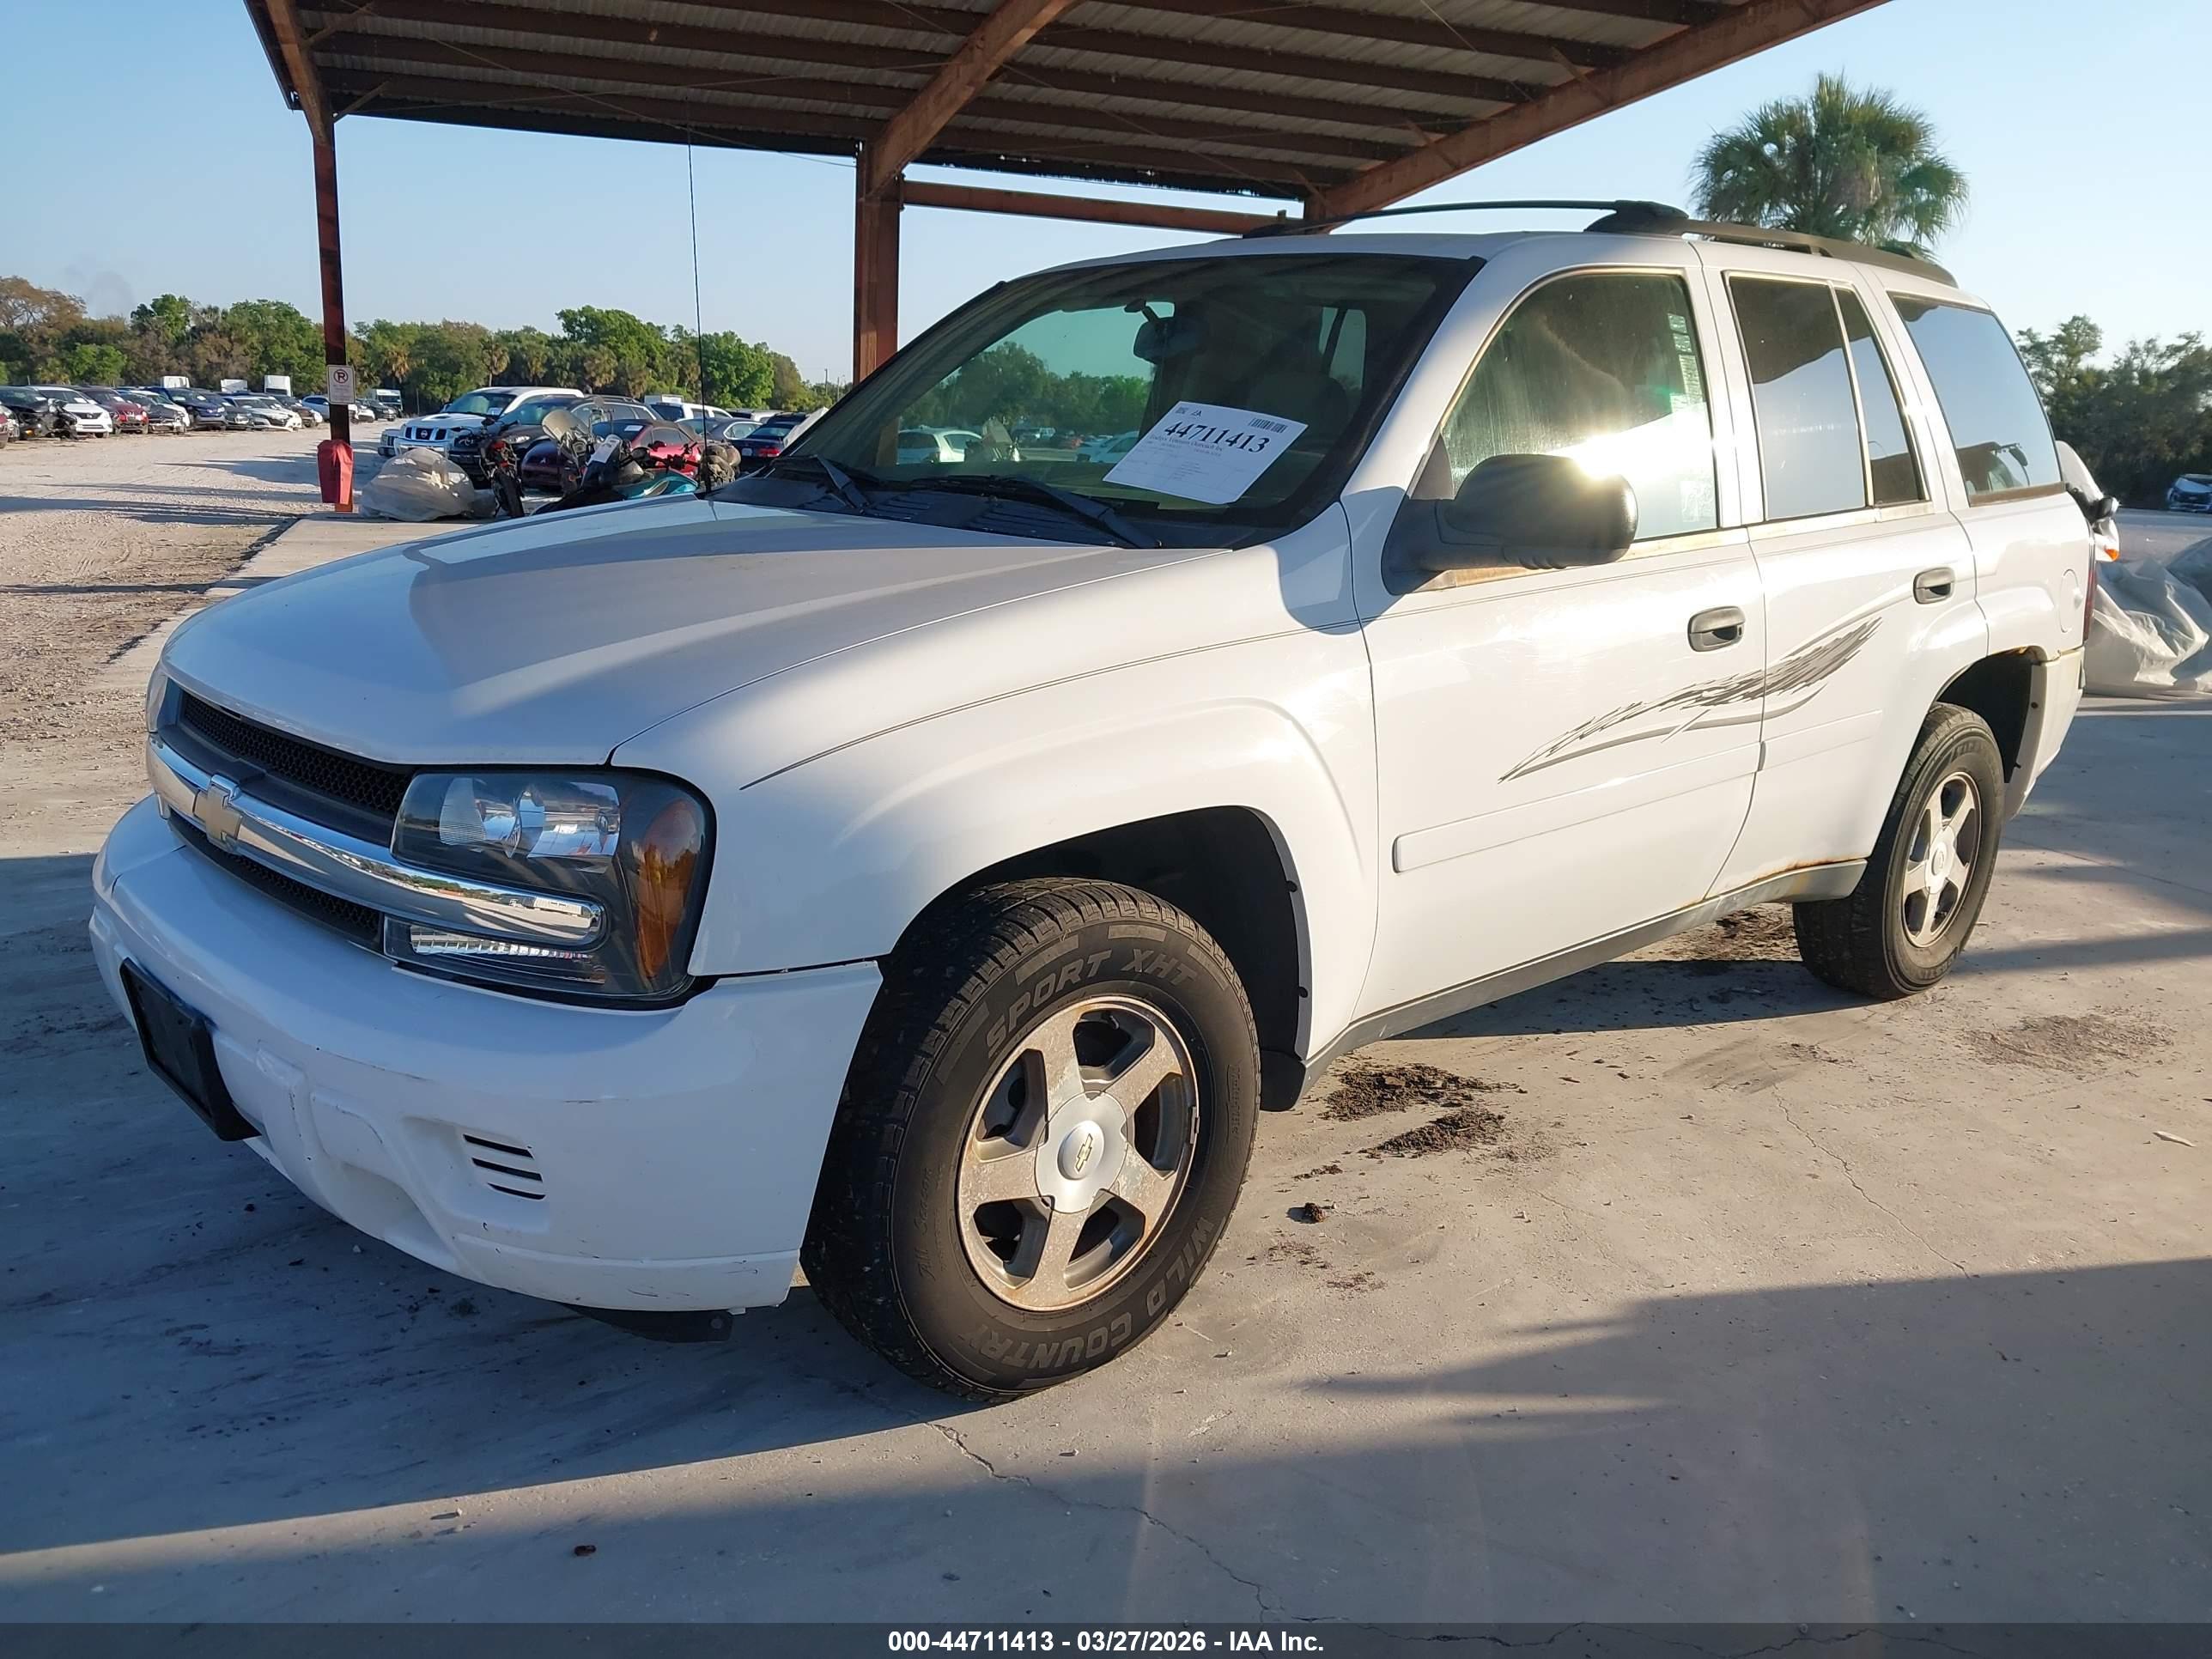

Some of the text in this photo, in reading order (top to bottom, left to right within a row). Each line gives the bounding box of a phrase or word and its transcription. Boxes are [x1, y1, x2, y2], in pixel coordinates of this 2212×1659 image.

[1164, 421, 1270, 453] 44711413
[987, 948, 1197, 1058] SPORT XHT
[1146, 1216, 1214, 1316] WILD
[956, 1312, 1133, 1368] COUNTRY
